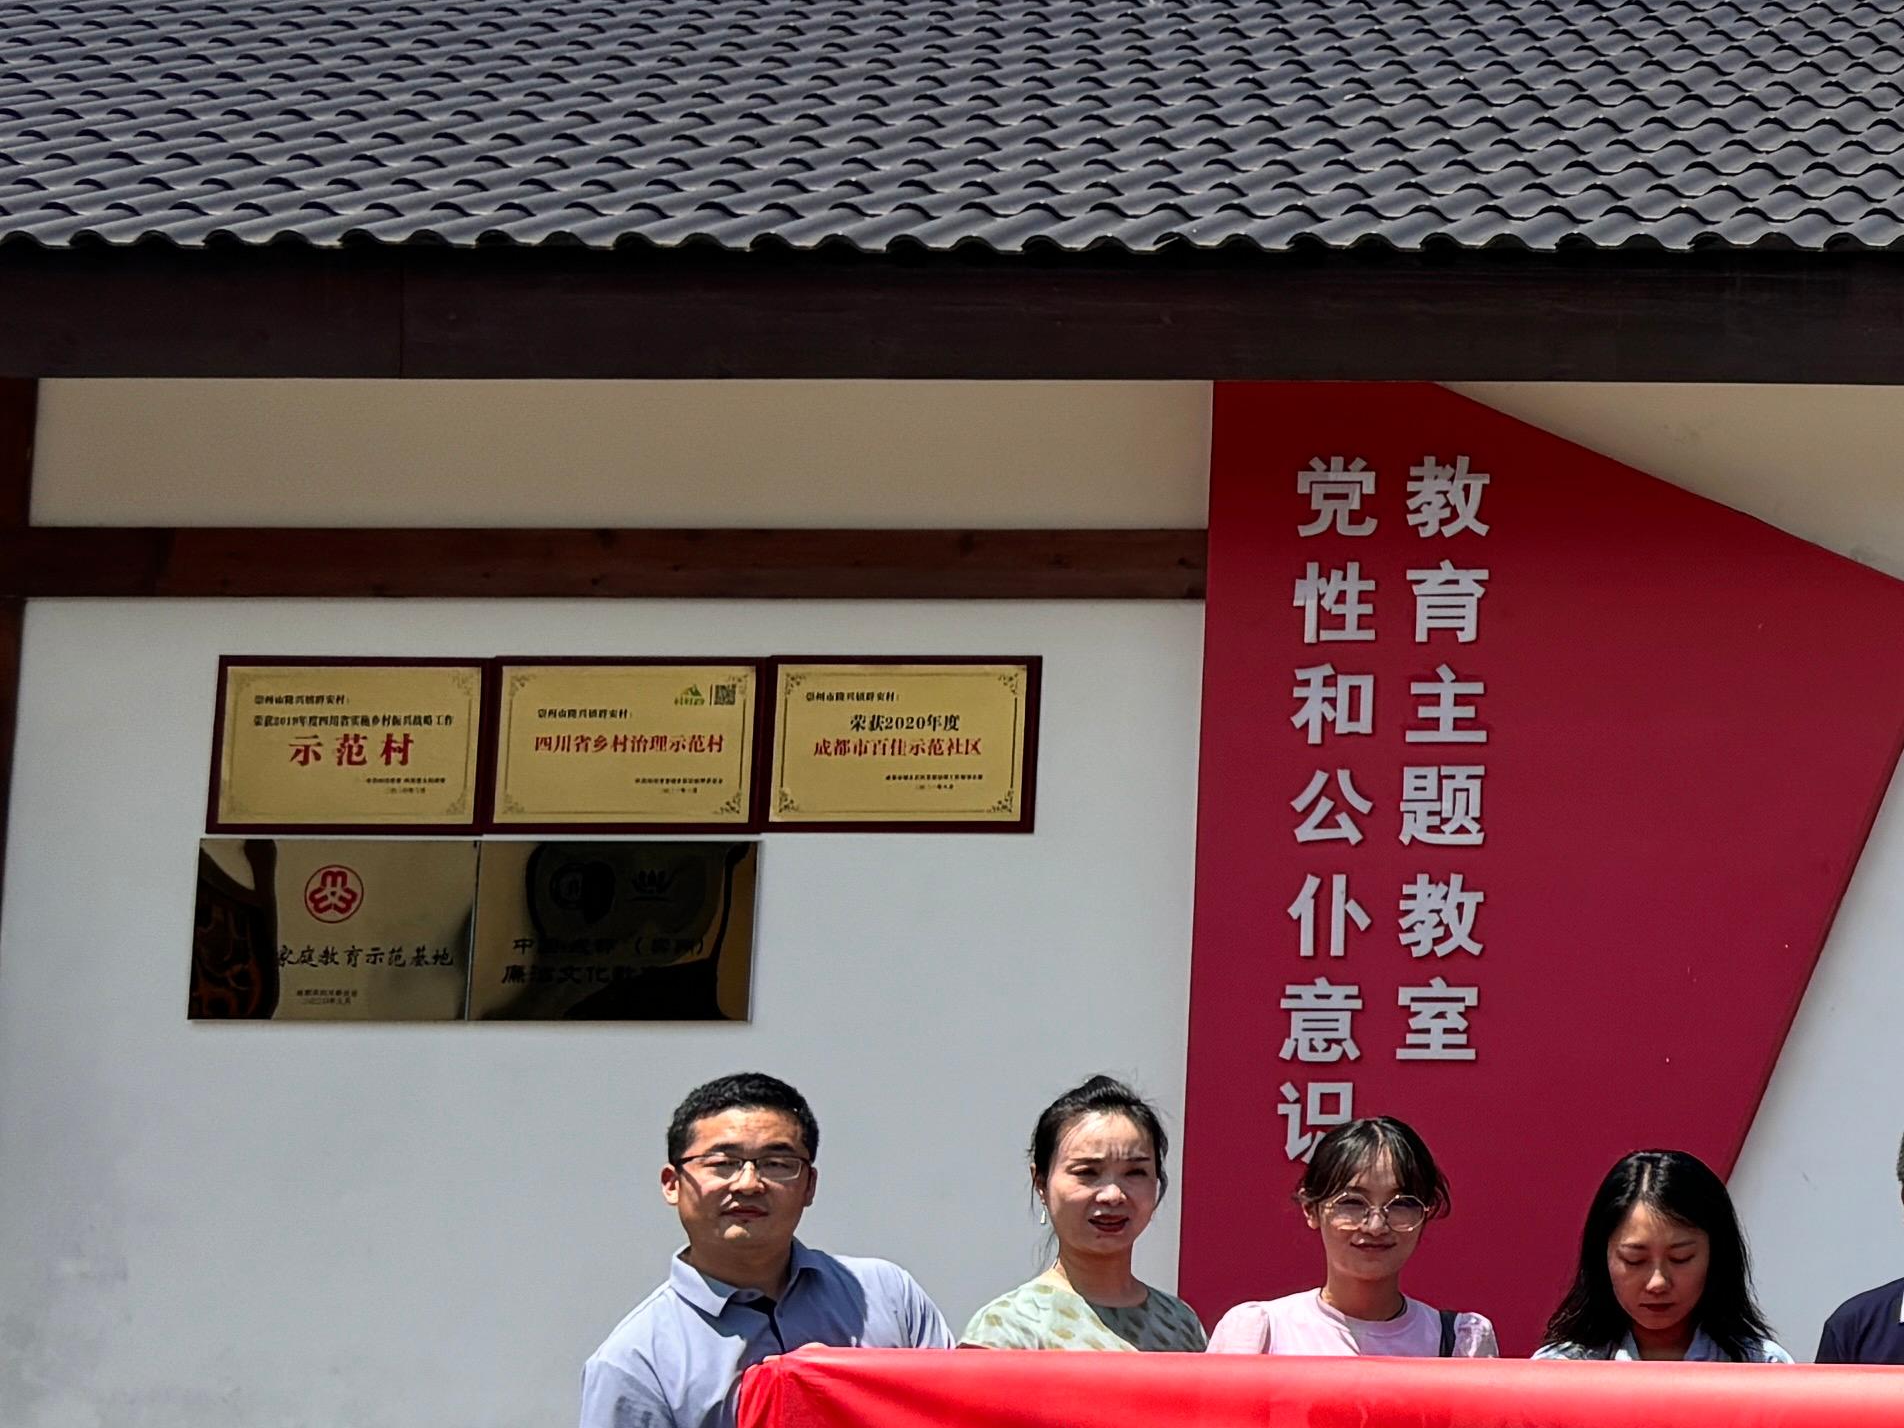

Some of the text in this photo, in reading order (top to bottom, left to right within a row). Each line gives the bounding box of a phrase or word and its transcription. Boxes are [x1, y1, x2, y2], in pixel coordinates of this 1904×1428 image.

[850, 714, 960, 732] 荣获2020年度
[288, 733, 414, 766] 示范村
[534, 734, 724, 753] 四川省乡村治理示范村
[813, 738, 982, 756] 成都市百佳示范社区
[1395, 455, 1491, 1062] 教育主题教室
[1277, 455, 1378, 1164] 党性和公仆意识
